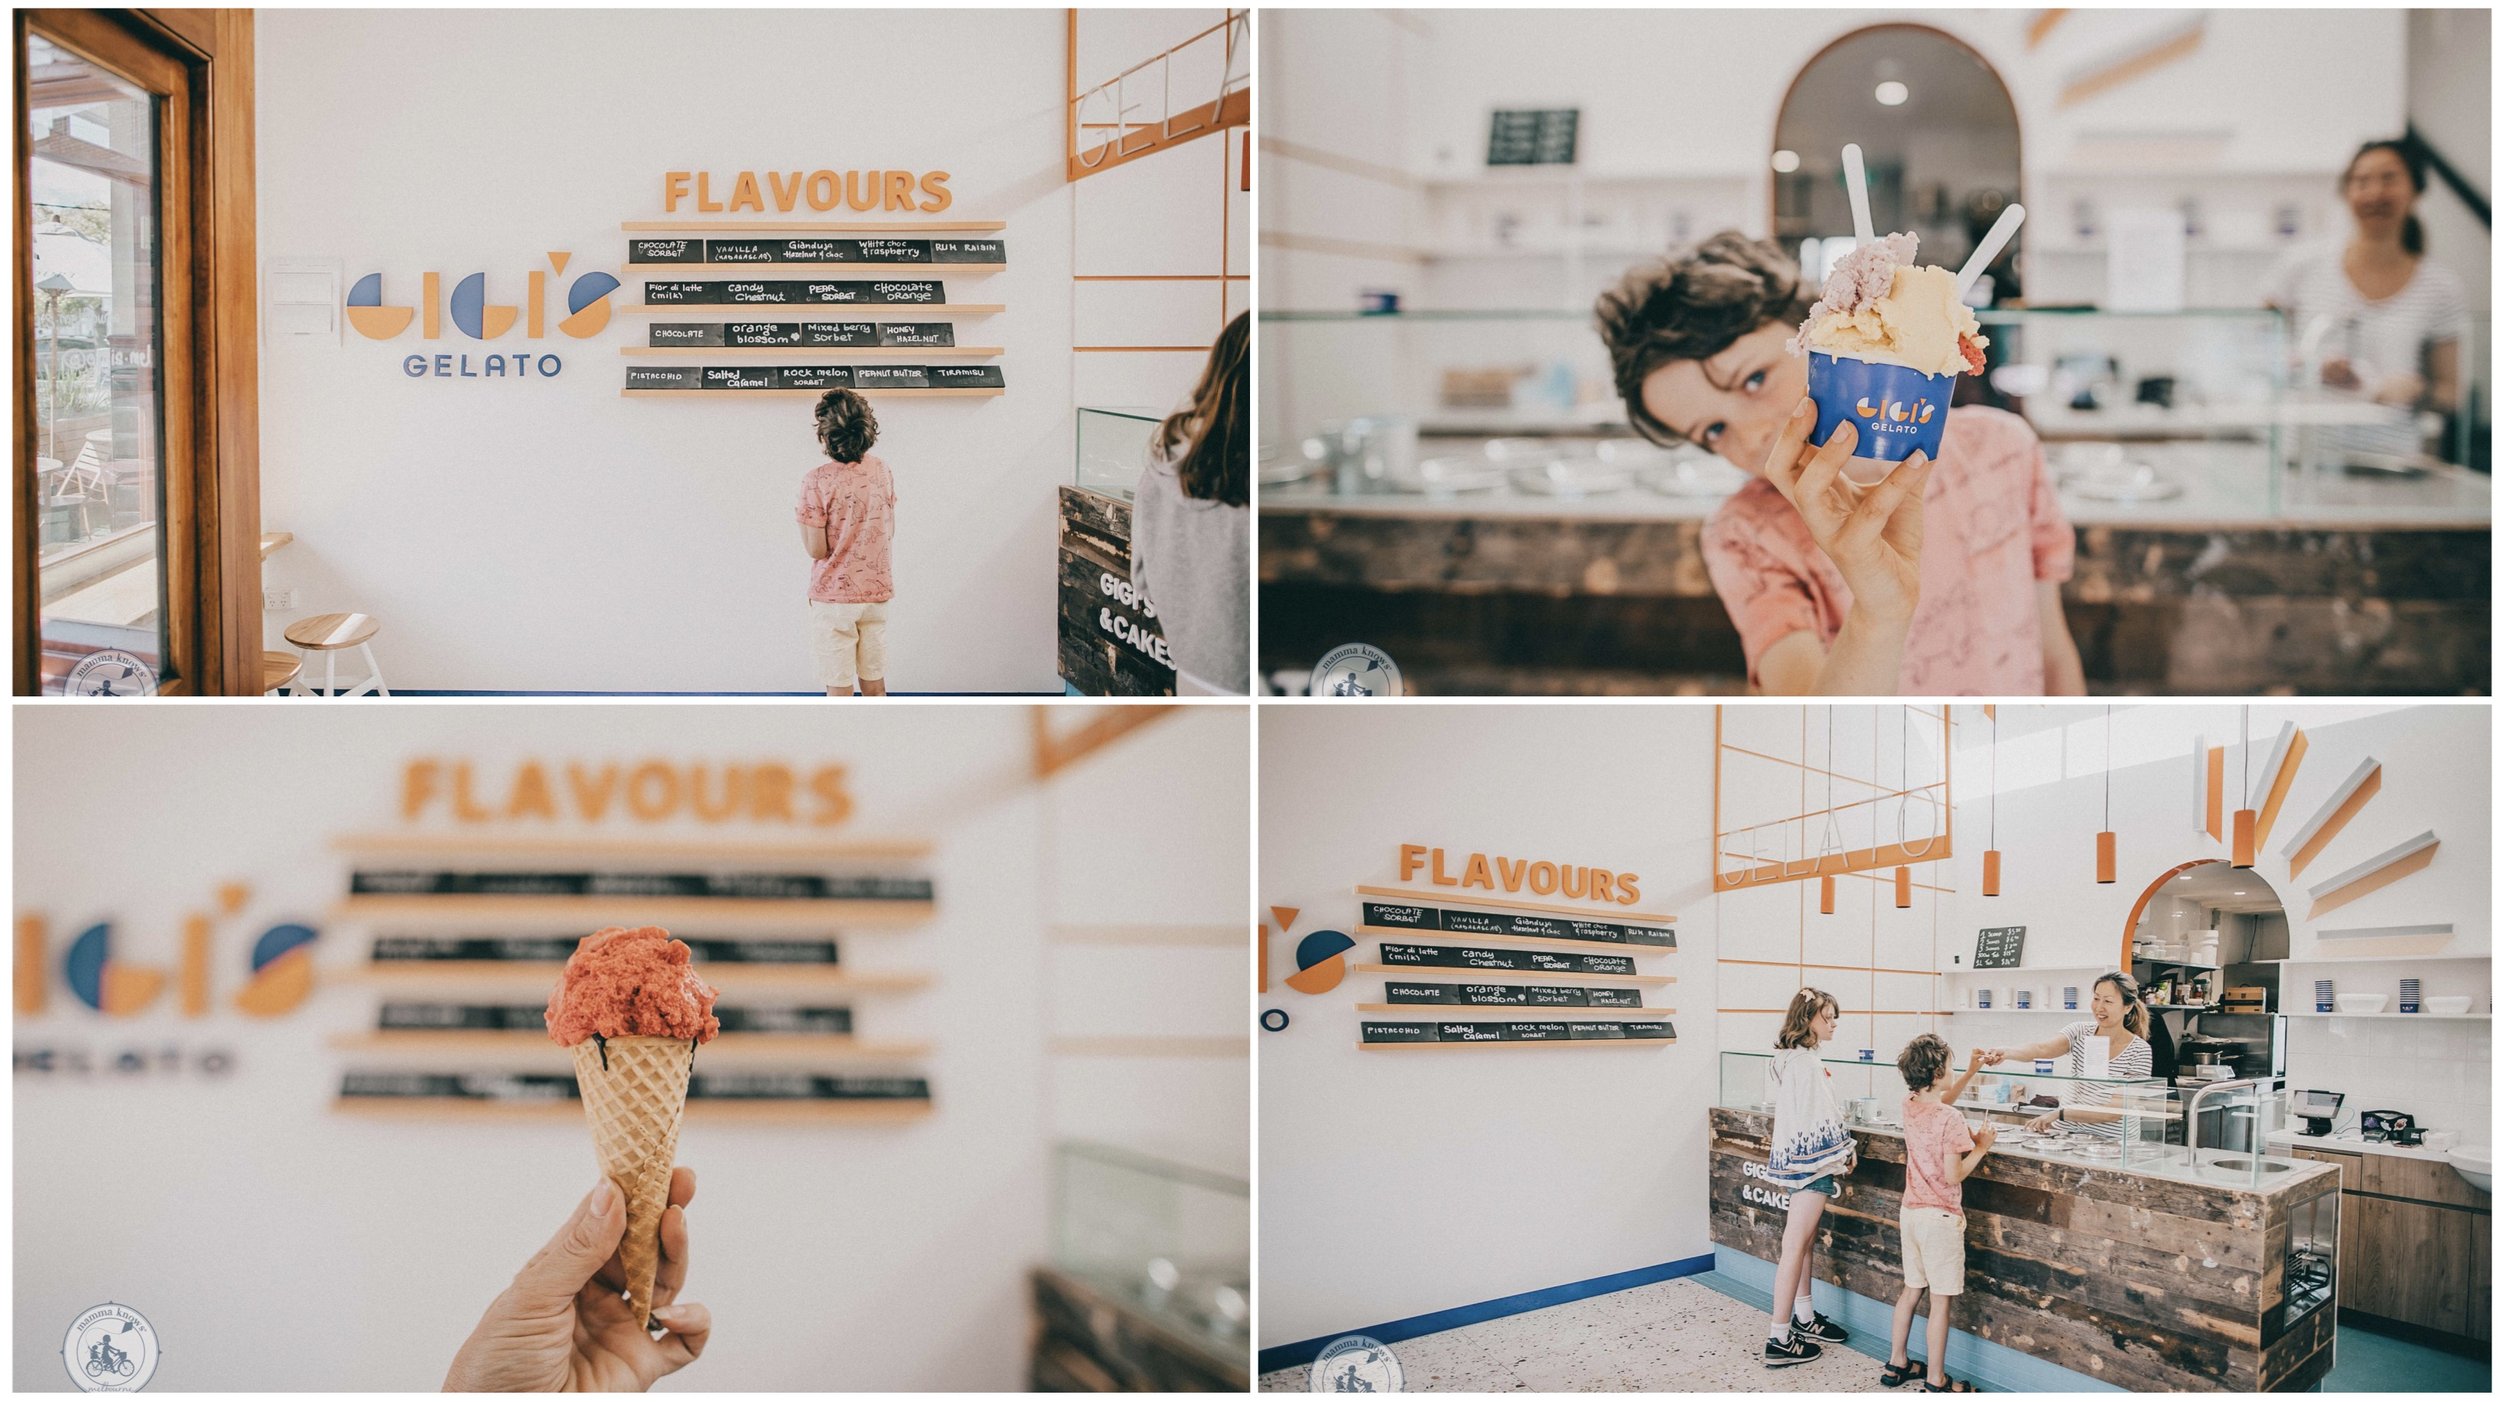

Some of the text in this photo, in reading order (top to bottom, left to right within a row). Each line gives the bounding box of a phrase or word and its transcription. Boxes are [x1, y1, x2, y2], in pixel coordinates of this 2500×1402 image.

[664, 170, 953, 212] FLAVOURS
[638, 241, 688, 250] CHOCOLATE
[788, 241, 833, 250] Gianduja
[887, 240, 907, 248] choc
[935, 243, 957, 251] RUM
[647, 250, 685, 258] SORBET
[826, 251, 844, 259] choc
[870, 248, 920, 258] raspberry
[649, 284, 703, 292] Fior di latte
[809, 284, 838, 294] PEAR
[346, 251, 621, 340] GIGI'S
[651, 292, 683, 300] (milk)
[735, 292, 786, 302] Chestnut
[822, 292, 857, 300] SORBET
[808, 324, 871, 333] Mixed berry
[886, 326, 915, 335] HONEY
[655, 330, 704, 338] CHOCOLATE
[896, 334, 940, 343] HAZELNUT
[737, 335, 789, 344] blossom
[403, 354, 562, 378] GELATO
[630, 372, 683, 380] PISTACCHIO
[707, 370, 740, 380] Salted
[817, 368, 848, 377] melon
[858, 369, 922, 378] PEANUT BUTTER
[938, 370, 985, 378] TIRAMISU
[1856, 397, 1935, 424] GIGI'S
[1872, 422, 1918, 434] GELATO
[1100, 572, 1157, 618] GIGI'S
[402, 758, 857, 827] FLAVOURS
[1400, 844, 1640, 905] FLAVOURS
[1374, 906, 1424, 916] CHOCOLATE
[1384, 914, 1419, 923] SORBET
[1451, 916, 1489, 924] VANILLA
[1392, 988, 1440, 996] CHOCOLATE
[1560, 987, 1581, 996] berry
[1472, 994, 1517, 1003] blossom
[1444, 1025, 1474, 1034] Salted
